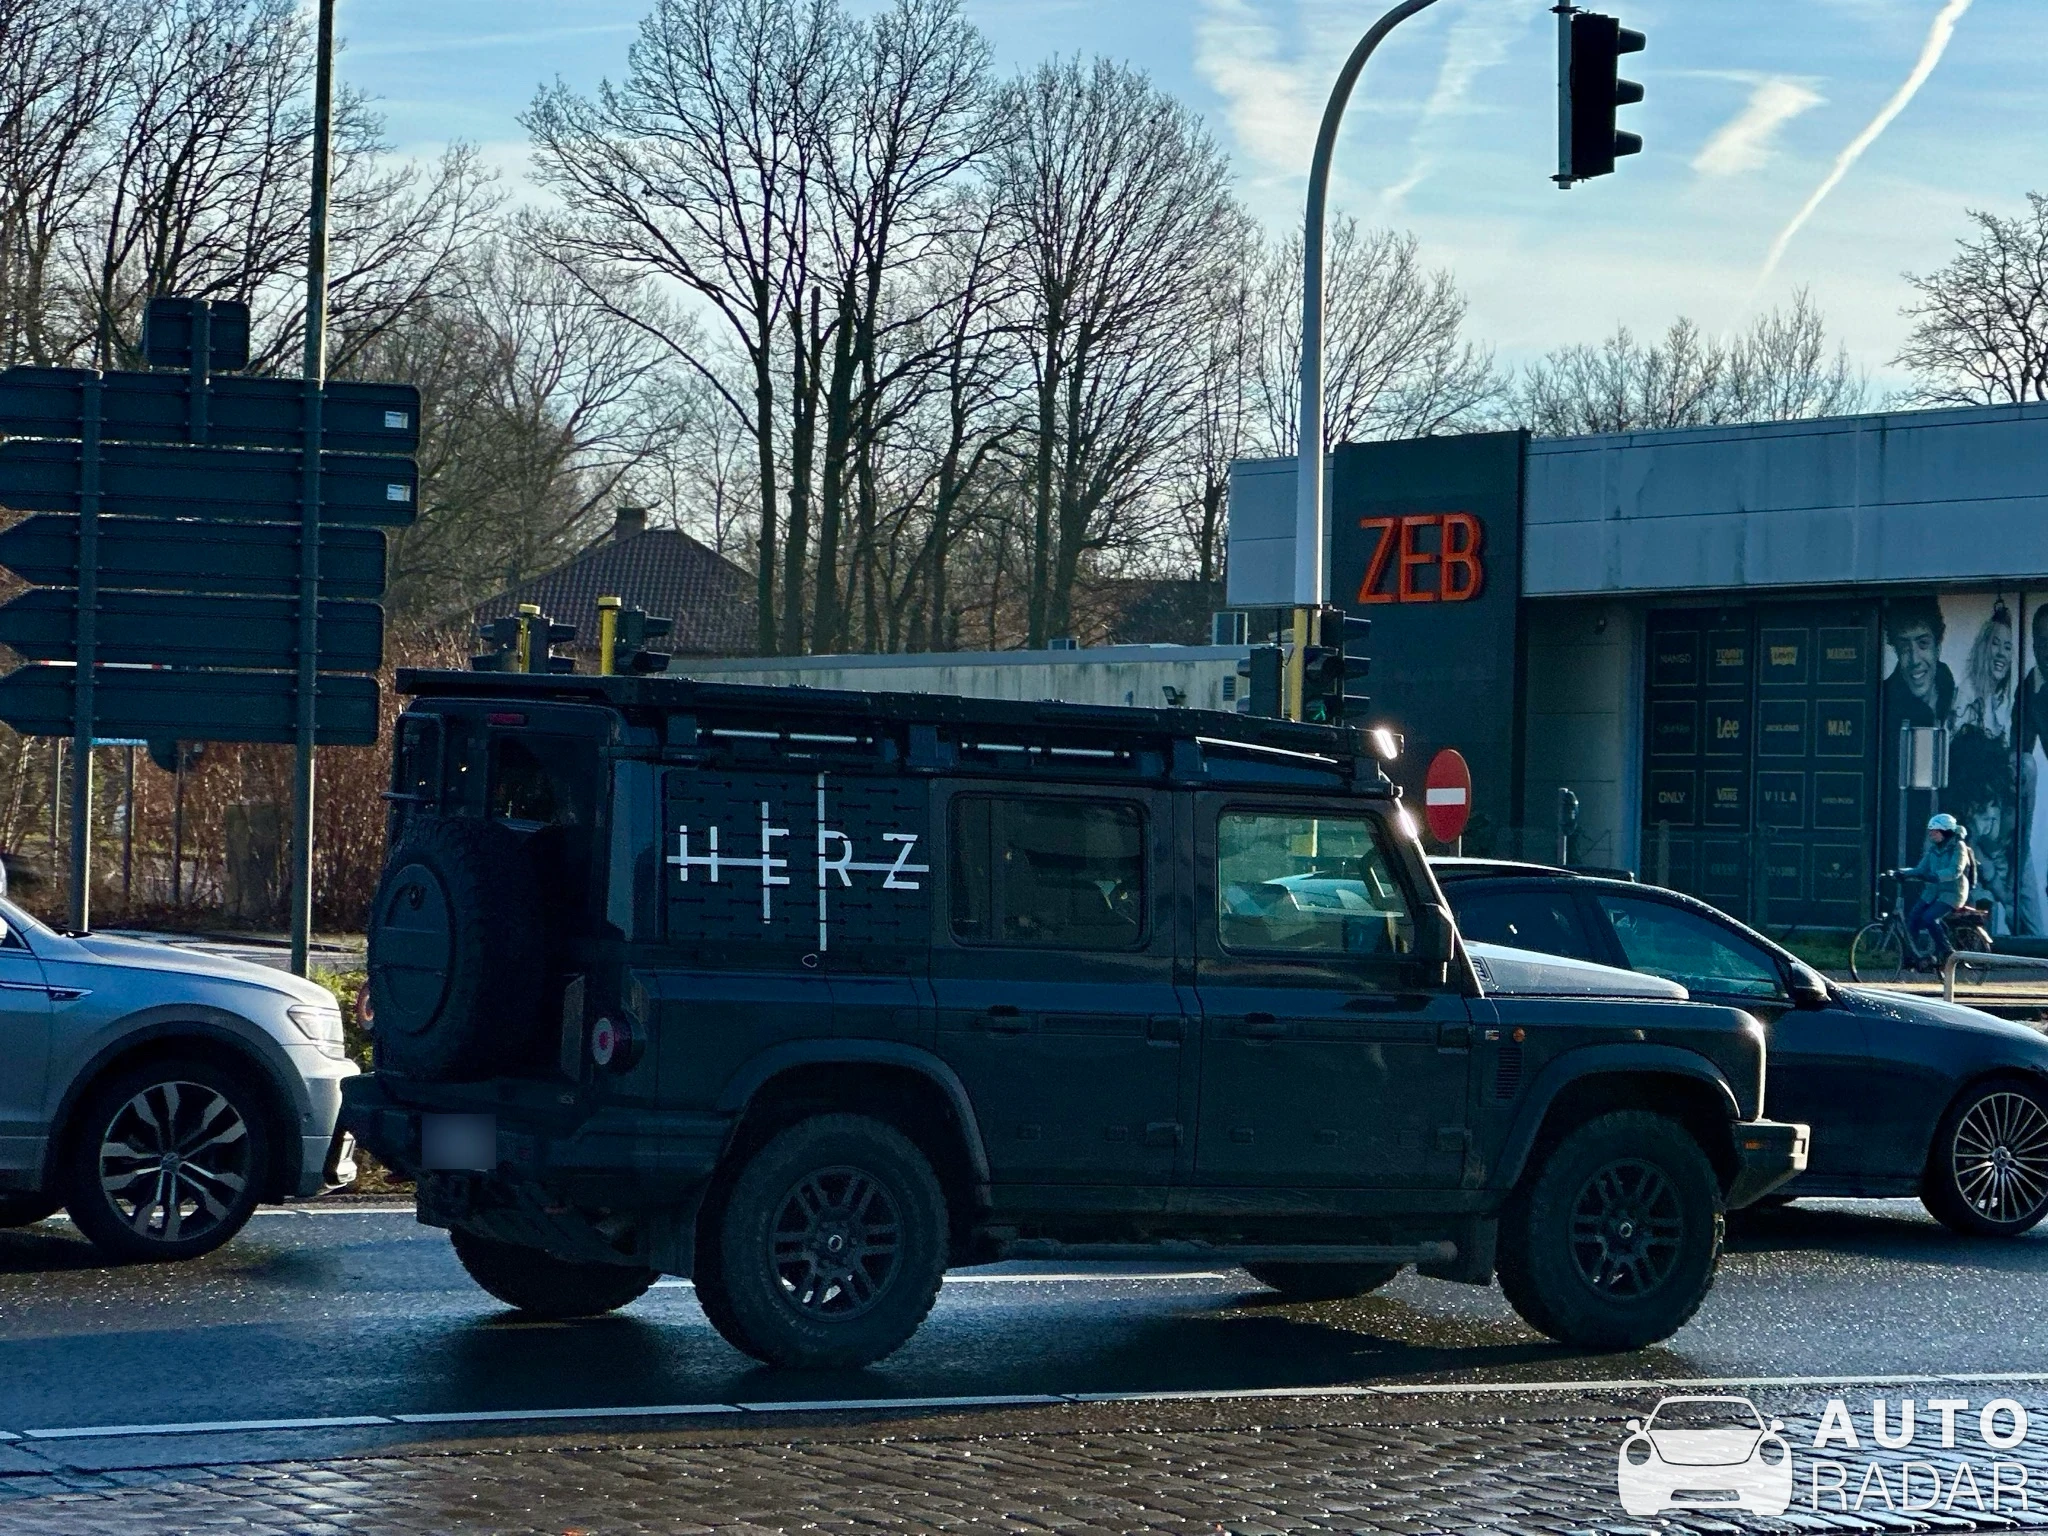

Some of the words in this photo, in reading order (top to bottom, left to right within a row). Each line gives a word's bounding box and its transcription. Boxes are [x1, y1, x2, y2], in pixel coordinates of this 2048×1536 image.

[1358, 512, 1483, 604] ZEB
[1715, 716, 1740, 739] Lee
[1827, 720, 1852, 737] MAC
[1658, 791, 1686, 804] ONLY
[1764, 791, 1798, 803] VILA
[666, 771, 930, 952] HERZ
